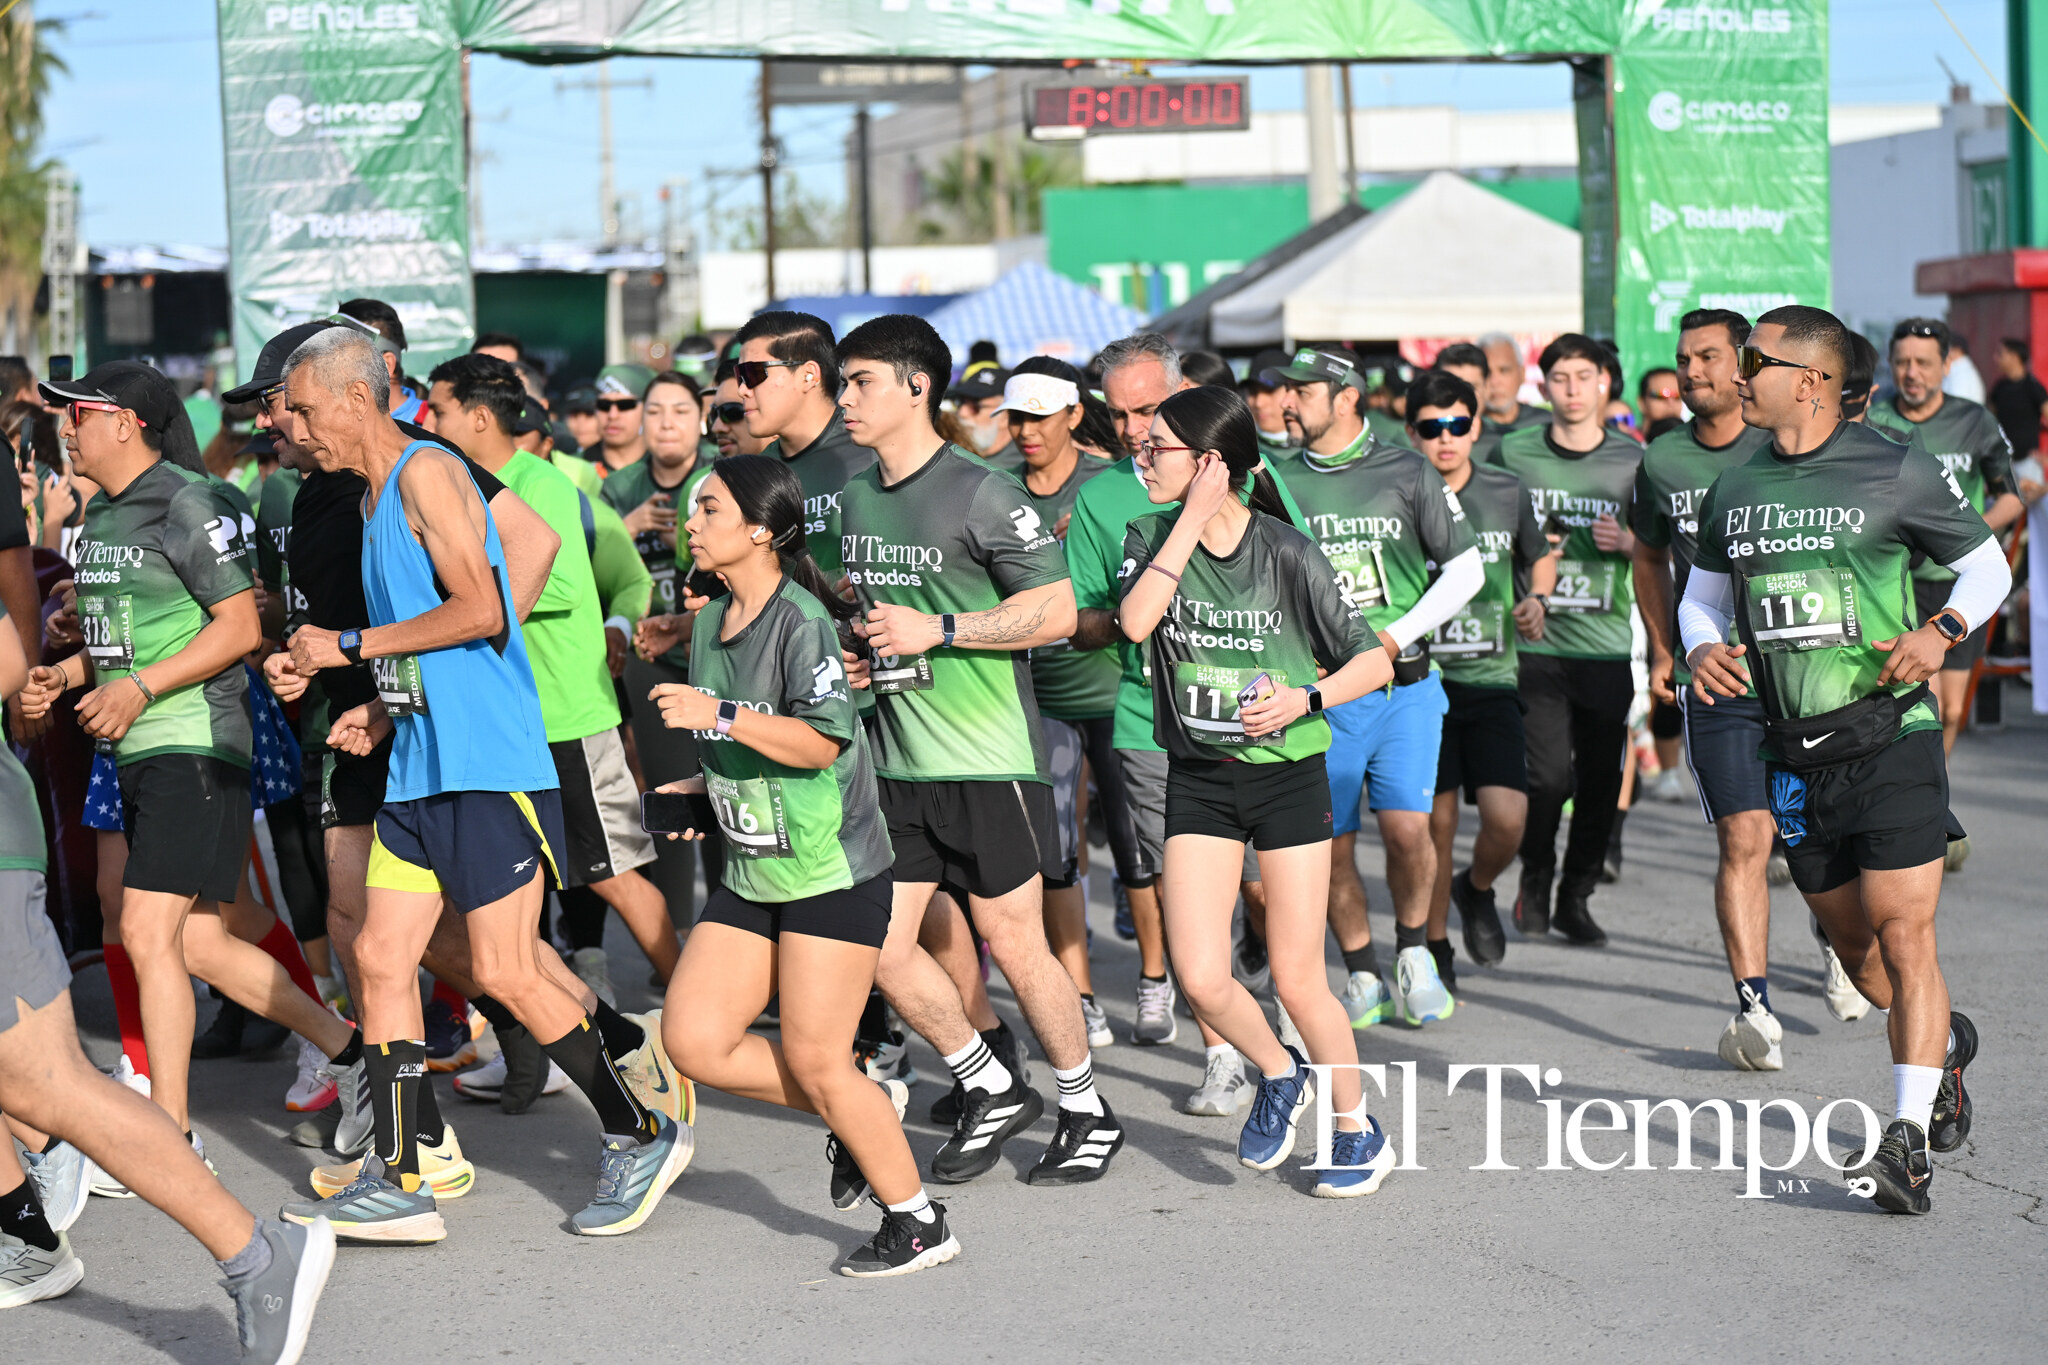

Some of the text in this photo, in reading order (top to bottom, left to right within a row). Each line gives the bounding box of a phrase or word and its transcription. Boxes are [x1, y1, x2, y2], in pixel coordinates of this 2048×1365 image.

[1686, 101, 1791, 120] cimaco
[1679, 204, 1786, 235] Totalplay
[1669, 490, 1692, 516] El
[1314, 513, 1402, 538] Tiempo
[1725, 503, 1865, 537] El Tiempo
[85, 541, 144, 568] Tiempo
[842, 535, 943, 572] El Tiempo
[1727, 533, 1835, 559] de todos
[74, 568, 121, 585] e todos
[863, 568, 922, 587] todos
[1556, 575, 1591, 597] 42
[1765, 573, 1807, 582] CARRERA
[1186, 600, 1282, 636] Tiempo
[1761, 592, 1824, 628] 119
[1844, 585, 1857, 637] MEDALLA
[84, 616, 111, 646] 318
[122, 611, 133, 660] MEDALLA
[1163, 623, 1265, 652] de todos
[373, 658, 399, 691] 544
[1196, 666, 1240, 677] CARRERA
[771, 783, 781, 791] 116
[712, 791, 759, 834] 116
[774, 797, 789, 849] MEDALLA
